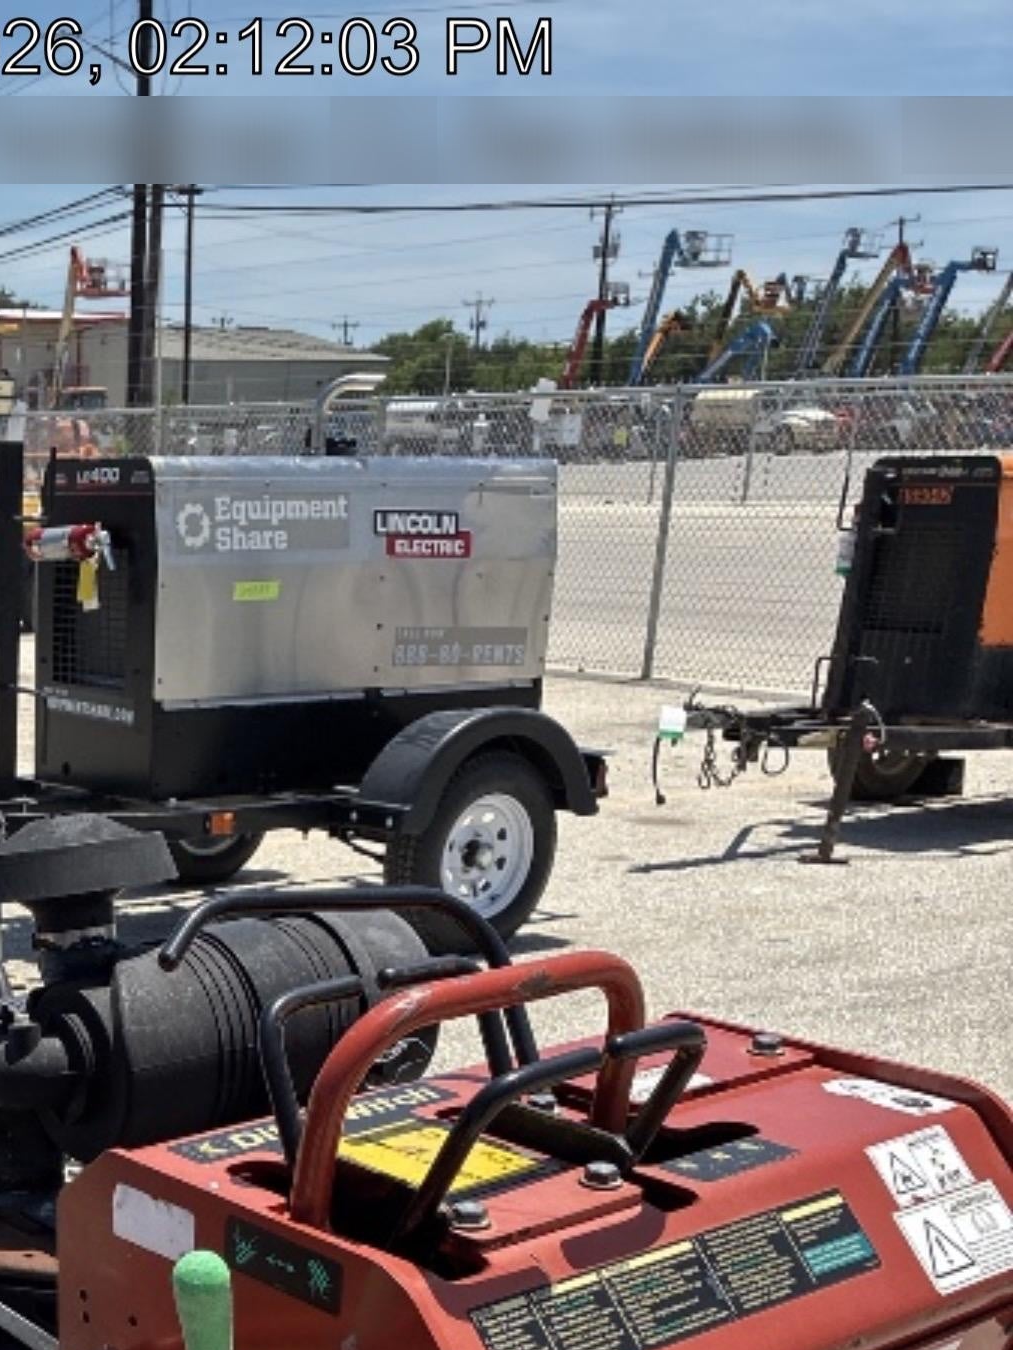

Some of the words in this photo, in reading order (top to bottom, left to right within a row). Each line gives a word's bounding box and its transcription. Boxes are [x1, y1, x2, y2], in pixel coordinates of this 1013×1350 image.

[214, 495, 349, 526] Equipment
[375, 511, 457, 535] LINCOLN
[215, 527, 288, 551] Share
[394, 539, 466, 556] ELECTRIC
